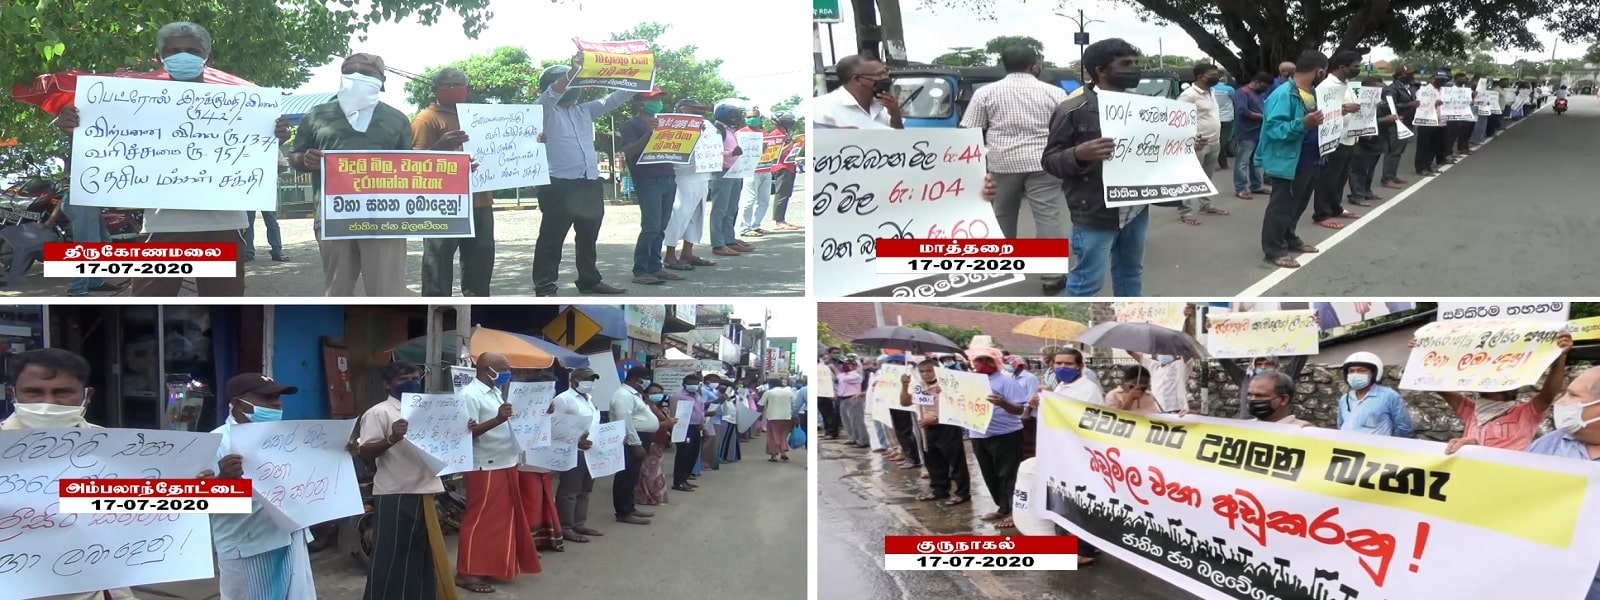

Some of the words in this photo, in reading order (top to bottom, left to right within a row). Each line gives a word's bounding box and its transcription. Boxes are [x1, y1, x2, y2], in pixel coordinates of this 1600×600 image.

[338, 158, 368, 175] විදුලි
[400, 159, 433, 175] වතුර
[436, 159, 458, 175] බිල
[411, 176, 443, 190] බැහැ
[921, 178, 964, 201] 104
[1109, 187, 1139, 199] ජාතික
[1141, 187, 1158, 198] ජන
[333, 196, 361, 213] වහා
[366, 199, 400, 212] සහන
[406, 195, 462, 216] ලබාදෙනු!
[1078, 407, 1136, 438] ජීවන
[1145, 421, 1188, 449] බර
[1196, 433, 1305, 482] උහුලනු
[1324, 448, 1451, 502] බැහැ
[1148, 466, 1201, 508] වහා
[1122, 533, 1163, 557] ජාතික
[1167, 550, 1193, 570] ජන
